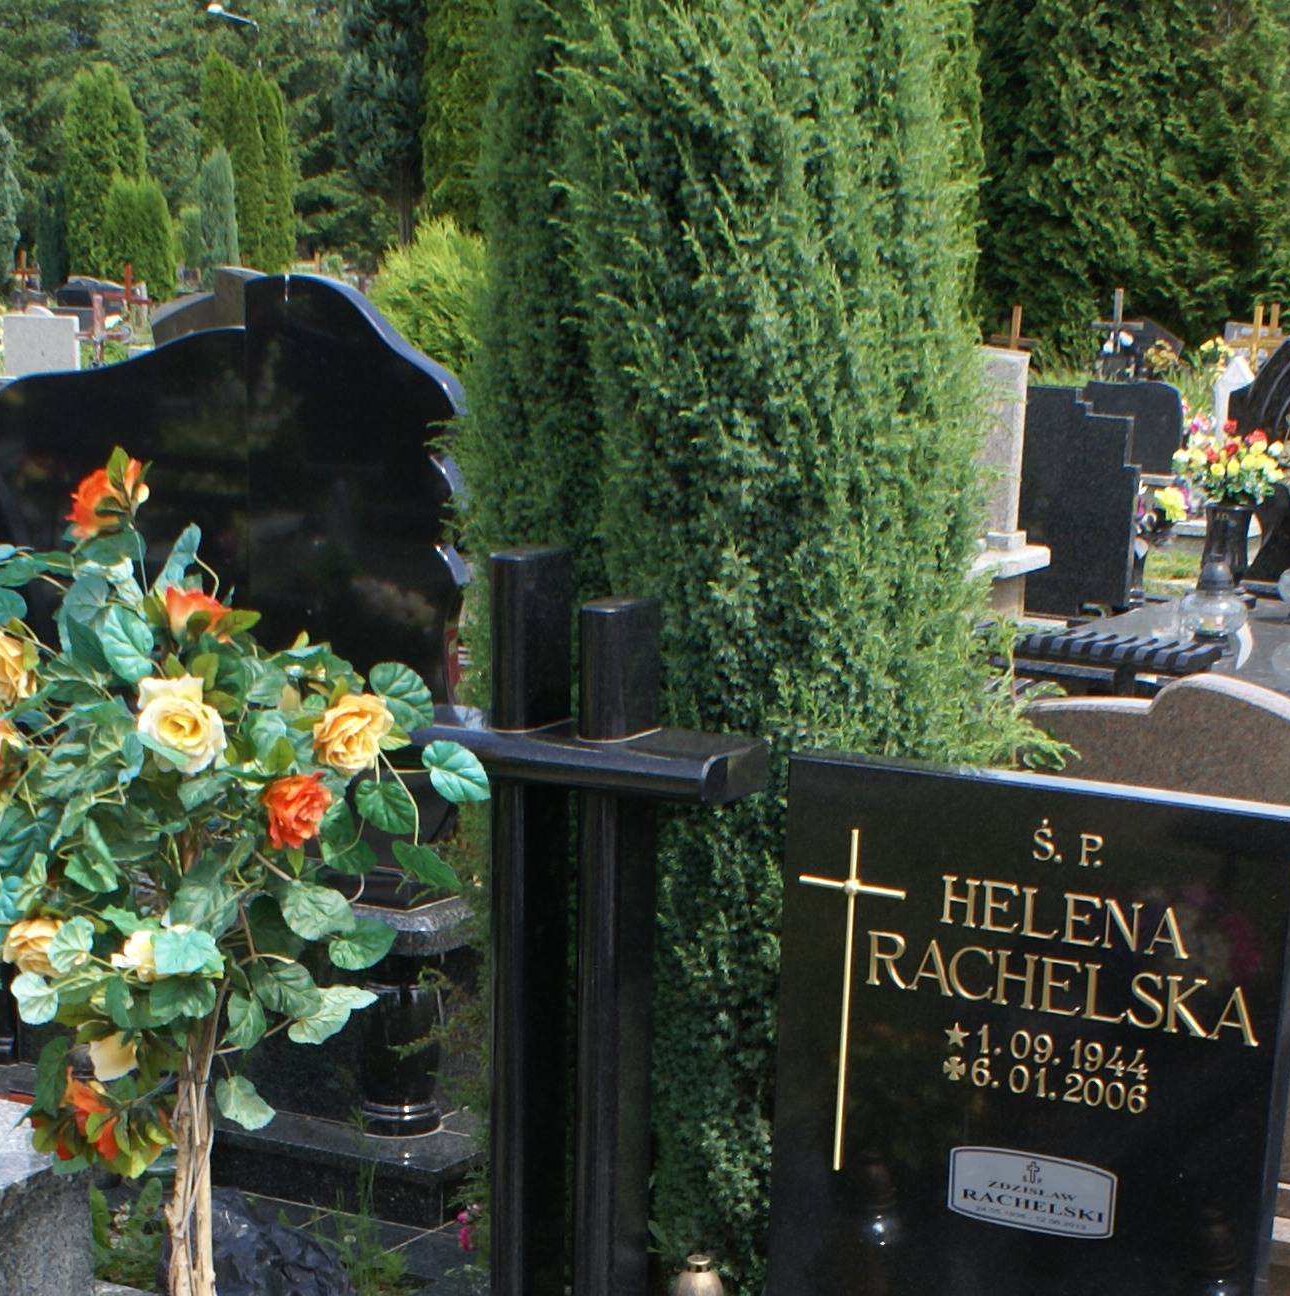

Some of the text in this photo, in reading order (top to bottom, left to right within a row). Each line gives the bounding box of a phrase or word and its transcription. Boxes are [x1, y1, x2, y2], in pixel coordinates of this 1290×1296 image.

[940, 875, 1189, 960] HELENA
[866, 930, 1259, 1048] RACHELSKA
[962, 1188, 1104, 1223] RACHELSKI
[988, 1180, 1078, 1202] ZDZISŁAW
